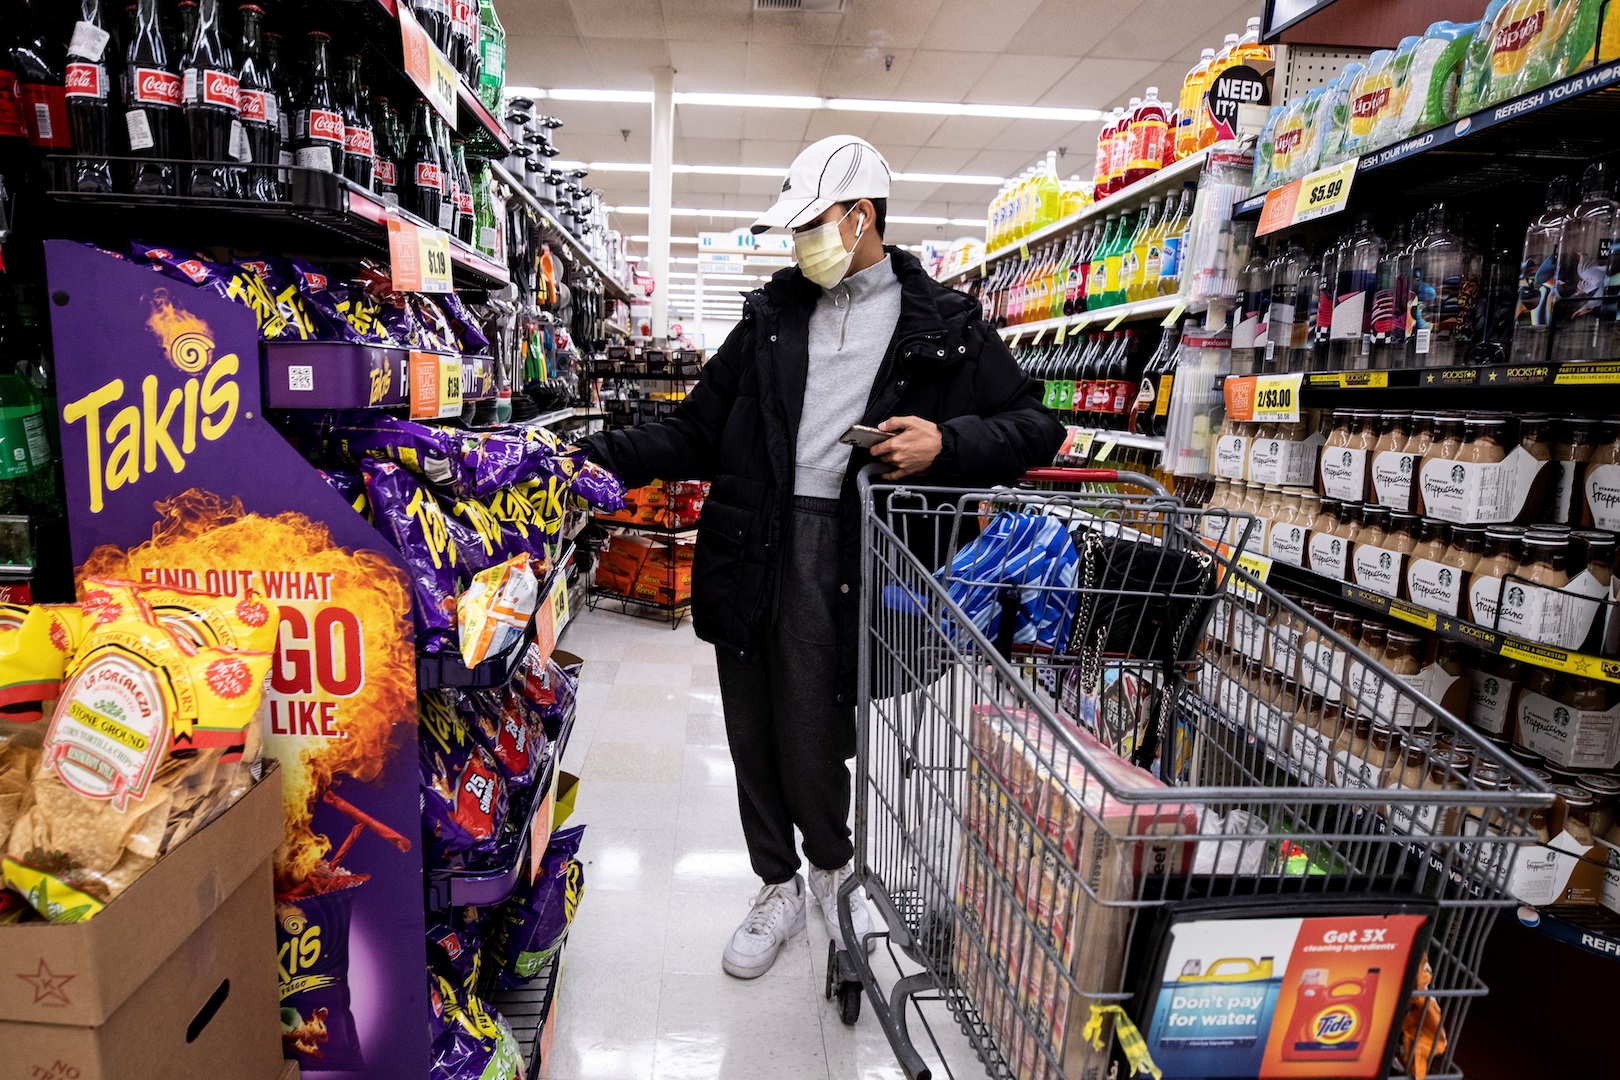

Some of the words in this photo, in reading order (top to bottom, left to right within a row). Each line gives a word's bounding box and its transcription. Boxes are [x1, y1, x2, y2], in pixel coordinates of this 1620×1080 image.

[1217, 78, 1263, 101] NEED
[1494, 92, 1545, 120] REFRESH
[1548, 79, 1584, 101] YOUR
[1215, 101, 1236, 117] IT?
[1380, 148, 1400, 163] YOUR
[1401, 134, 1434, 153] WORLD
[1309, 179, 1343, 205] $5.99
[1320, 204, 1335, 215] $1.00
[737, 234, 756, 247] 10
[428, 249, 446, 275] $1.19
[1442, 370, 1477, 380] ROCKSTAR
[1507, 367, 1548, 377] ROCKSTAR
[1257, 388, 1291, 409] 2/$3.00
[63, 354, 240, 514] Takis
[1218, 446, 1241, 466] frappuccino
[1252, 450, 1278, 470] frappuccino
[1323, 460, 1351, 480] frappuccino
[1376, 465, 1412, 488] frappuccino
[1424, 473, 1464, 497] frappuccino
[1272, 534, 1300, 553] frappuccino
[1312, 545, 1340, 566] frappuccino
[1357, 557, 1391, 581] frappuccino
[205, 569, 253, 599] OUT
[261, 571, 333, 601] WHAT
[1412, 573, 1452, 599] frappuccino
[1475, 591, 1524, 621] frappccino
[1459, 624, 1496, 642] ROCKSTAR
[271, 605, 364, 698] GO
[1503, 640, 1518, 649] PARTY
[1519, 643, 1531, 651] LIKE
[1535, 648, 1567, 660] ROCKSTAR
[84, 675, 96, 690] LA
[98, 669, 152, 719] FORTALEZA
[70, 704, 98, 728] STONE
[101, 721, 145, 750] GROUND
[270, 701, 348, 740] LIKE.
[1523, 706, 1568, 739] frappuccino
[62, 725, 79, 737] CORN
[80, 729, 113, 754] TORTILLA
[113, 747, 133, 769] CHIPS
[464, 772, 487, 799] 25
[479, 777, 496, 815] singles
[1417, 848, 1444, 873] YUR
[1323, 929, 1358, 944] Get
[1360, 928, 1389, 943] 3X
[1303, 943, 1342, 953] cleaning
[281, 980, 307, 996] FUEGO
[1172, 995, 1225, 1010] Don't
[1227, 996, 1264, 1010] pay
[1168, 1012, 1198, 1027] for
[1201, 1013, 1258, 1027] water.
[1315, 1013, 1354, 1039] Tide
[51, 1059, 81, 1080] NO
